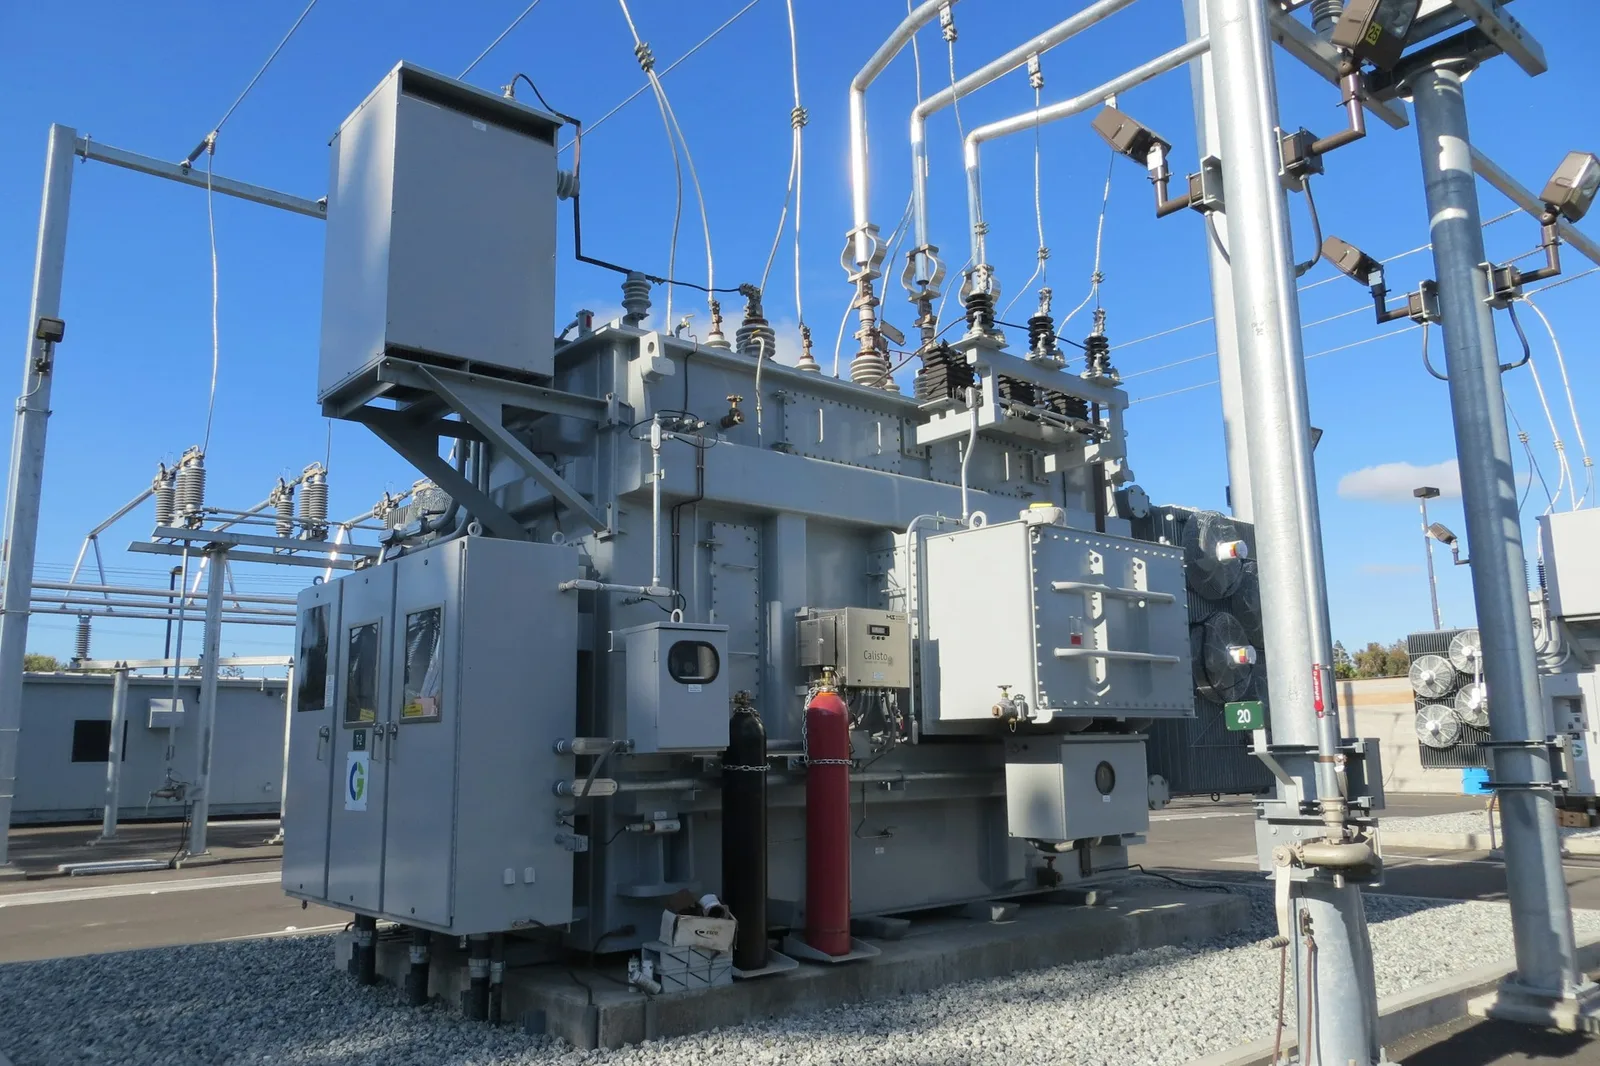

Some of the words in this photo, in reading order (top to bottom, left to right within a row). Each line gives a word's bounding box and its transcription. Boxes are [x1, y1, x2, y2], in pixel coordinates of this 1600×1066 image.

[1368, 25, 1380, 41] 25
[863, 650, 888, 661] Calisto
[1237, 709, 1251, 723] 20
